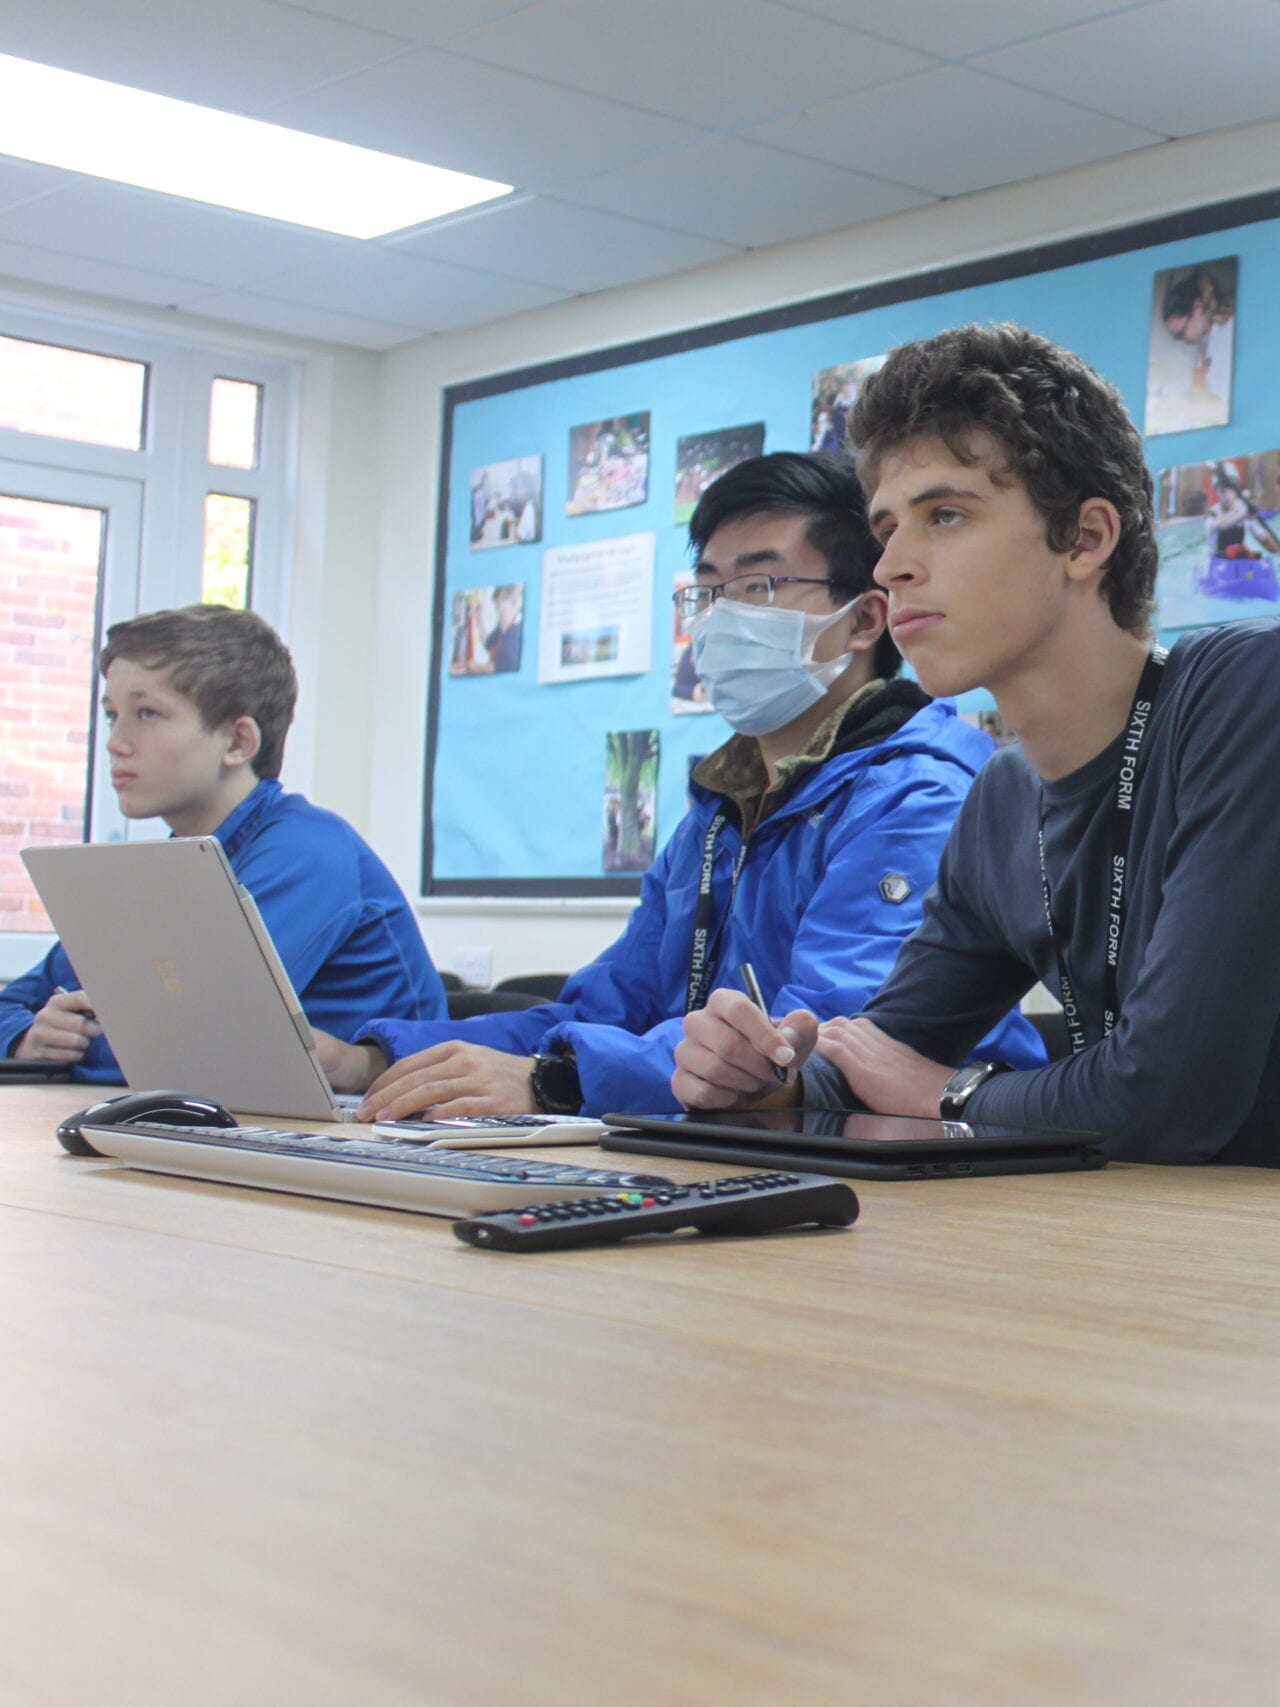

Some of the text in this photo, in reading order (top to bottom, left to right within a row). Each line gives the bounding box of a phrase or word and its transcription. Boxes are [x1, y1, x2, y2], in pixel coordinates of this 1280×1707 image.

[1117, 700, 1152, 811] SIXTH FORM
[700, 814, 726, 895] SIXTH FORM
[691, 928, 707, 970] SIXTH
[1107, 855, 1125, 967] SIXTH FORM
[1061, 976, 1081, 1028] FORM
